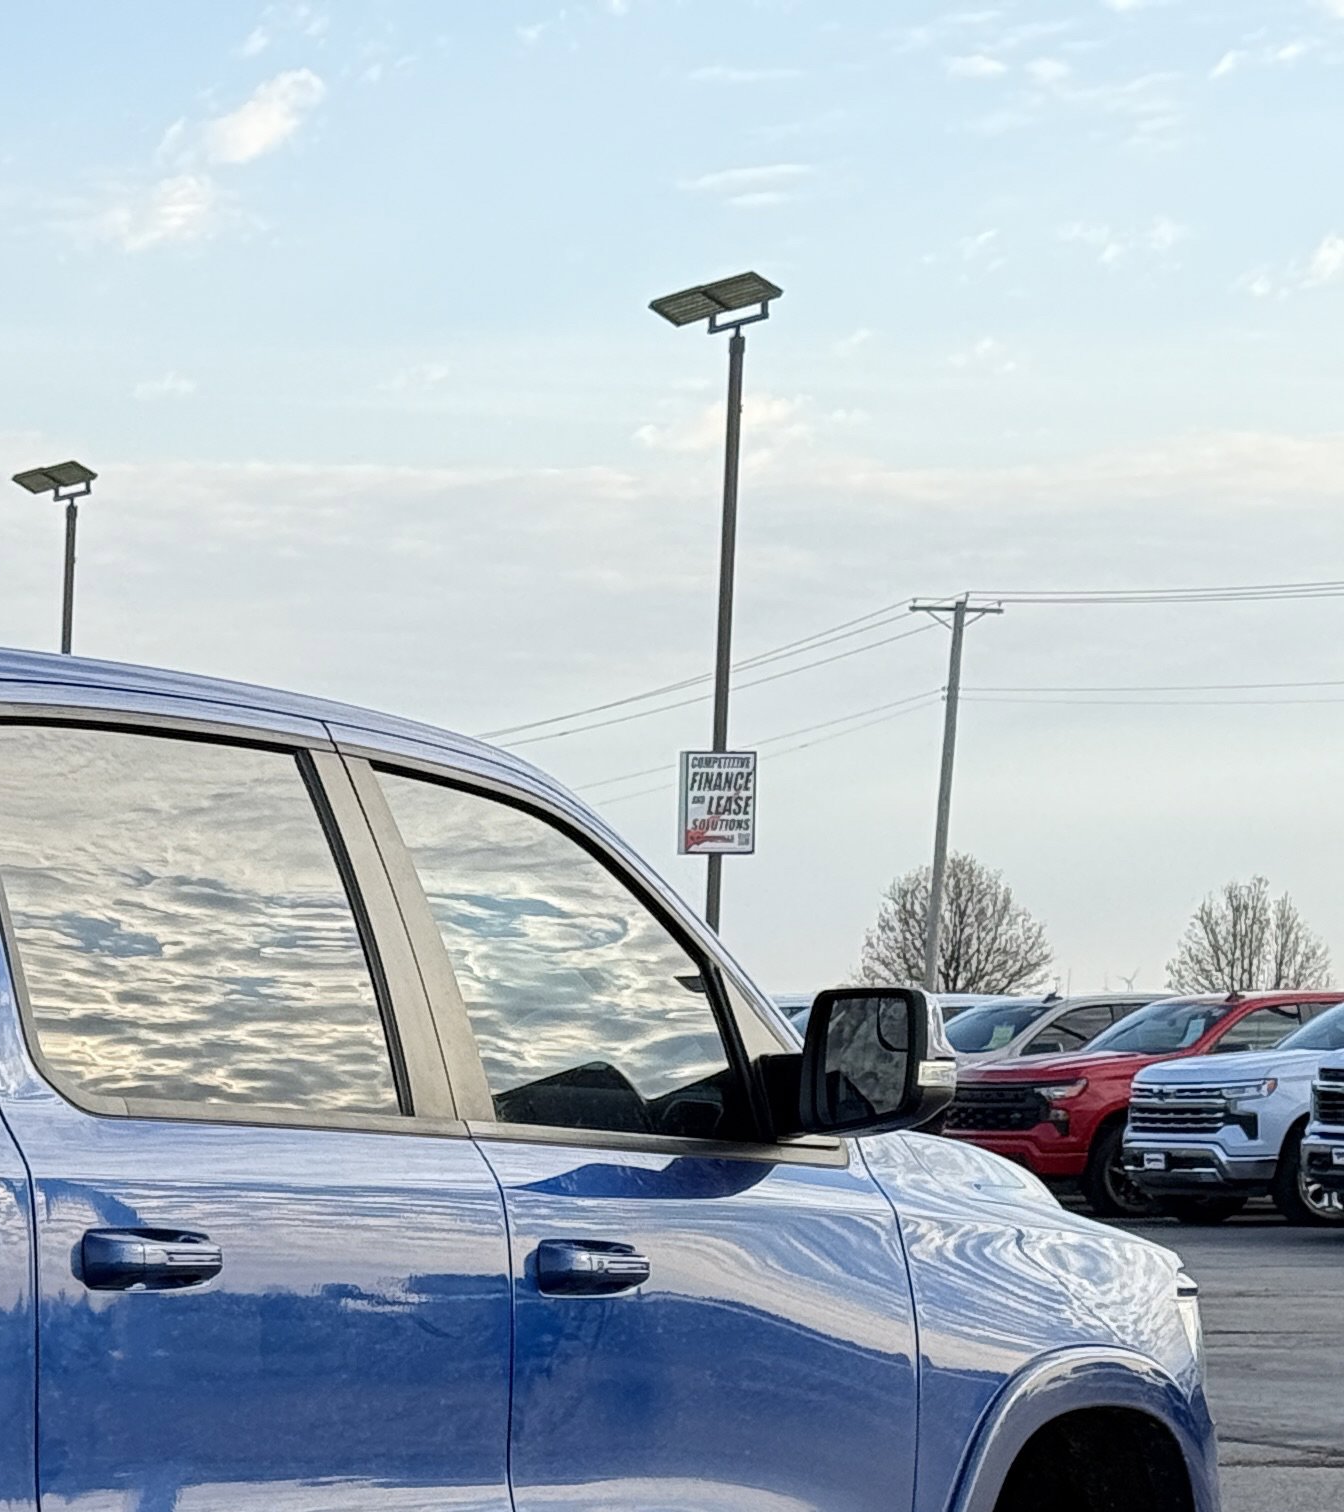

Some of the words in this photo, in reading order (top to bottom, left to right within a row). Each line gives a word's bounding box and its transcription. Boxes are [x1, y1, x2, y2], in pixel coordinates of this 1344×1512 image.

[691, 756, 751, 769] COMPETITIVE
[690, 772, 753, 792] FINANCE
[706, 795, 753, 816] LEASE
[691, 818, 751, 832] SOLUTIONS
